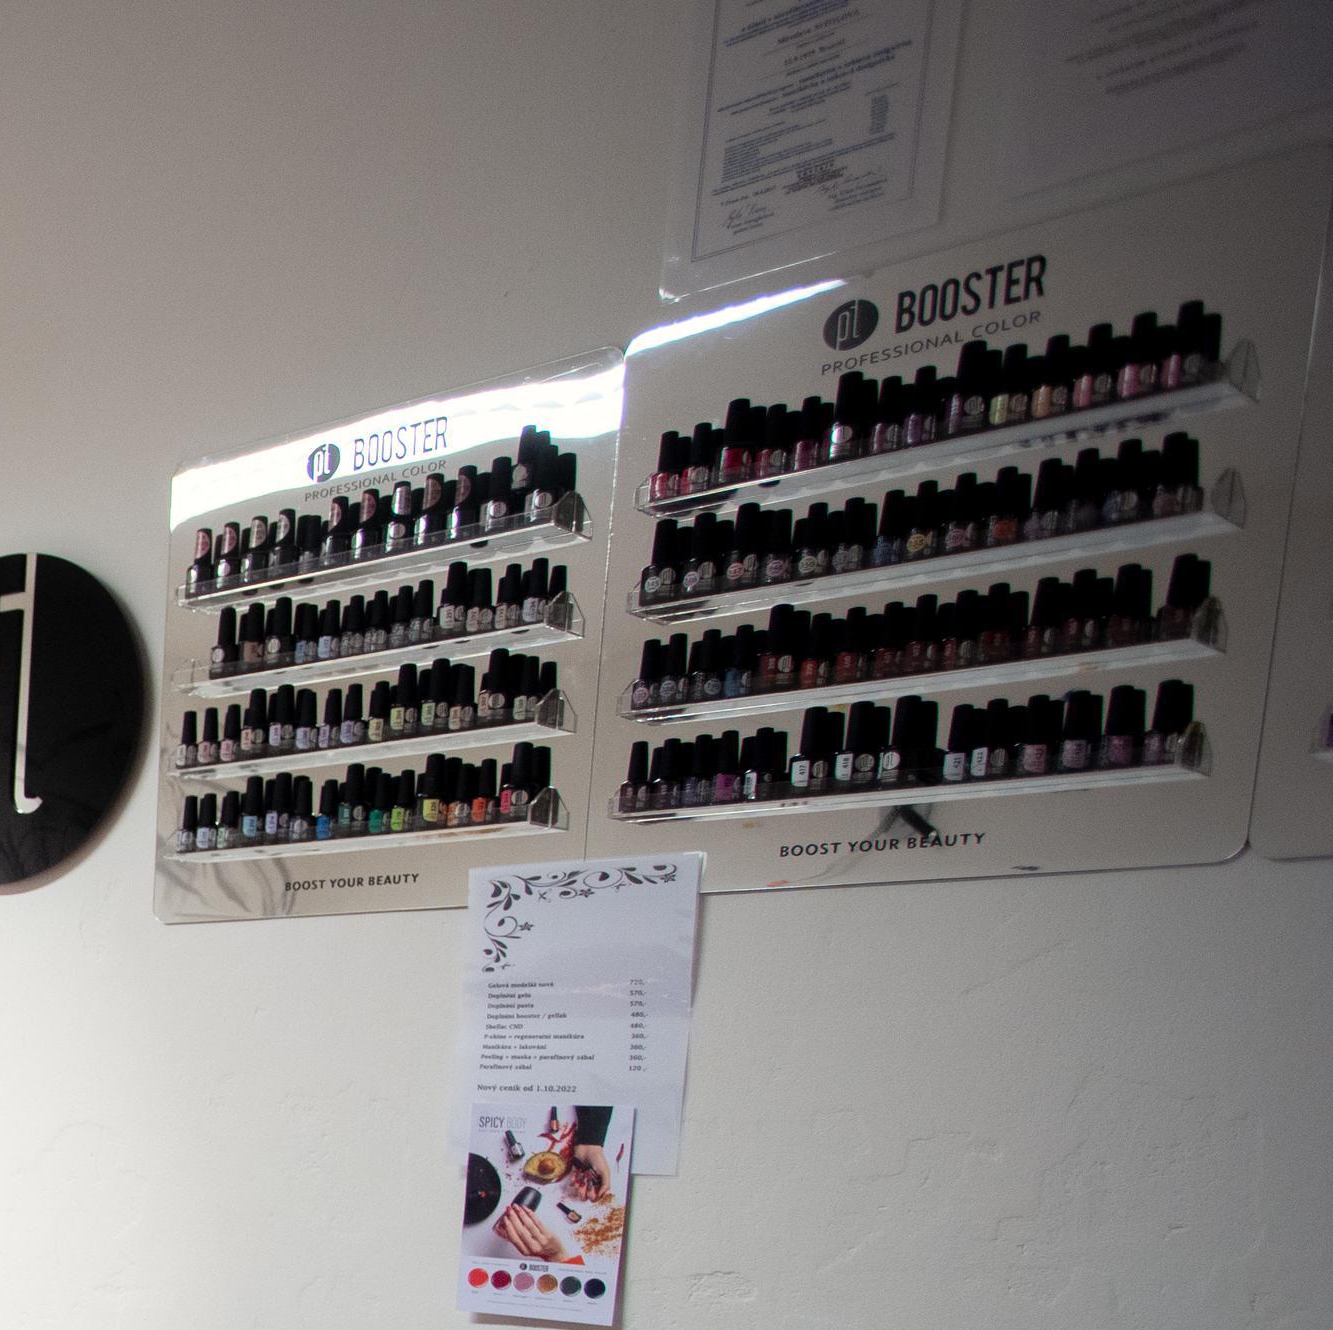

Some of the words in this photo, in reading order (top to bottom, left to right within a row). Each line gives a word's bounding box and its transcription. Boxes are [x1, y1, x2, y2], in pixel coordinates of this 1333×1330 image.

[895, 254, 1047, 334] BOOSTER
[821, 331, 964, 376] PROFESSIONAL
[972, 311, 1041, 339] COLOR
[353, 415, 448, 472] BOOSTER
[304, 471, 397, 502] PROFESSIONAL
[402, 459, 447, 479] COLOR
[780, 842, 841, 857] BOOST
[848, 838, 899, 853] YOUR
[907, 832, 986, 849] BEAUTY
[285, 880, 326, 892] BOOST
[330, 877, 364, 888] YOUR
[368, 873, 420, 886] BEAUTY
[477, 1083, 497, 1092] Nový
[523, 1084, 533, 1092] od
[536, 1085, 577, 1093] 1.10.2022
[479, 1116, 505, 1128] SPICY
